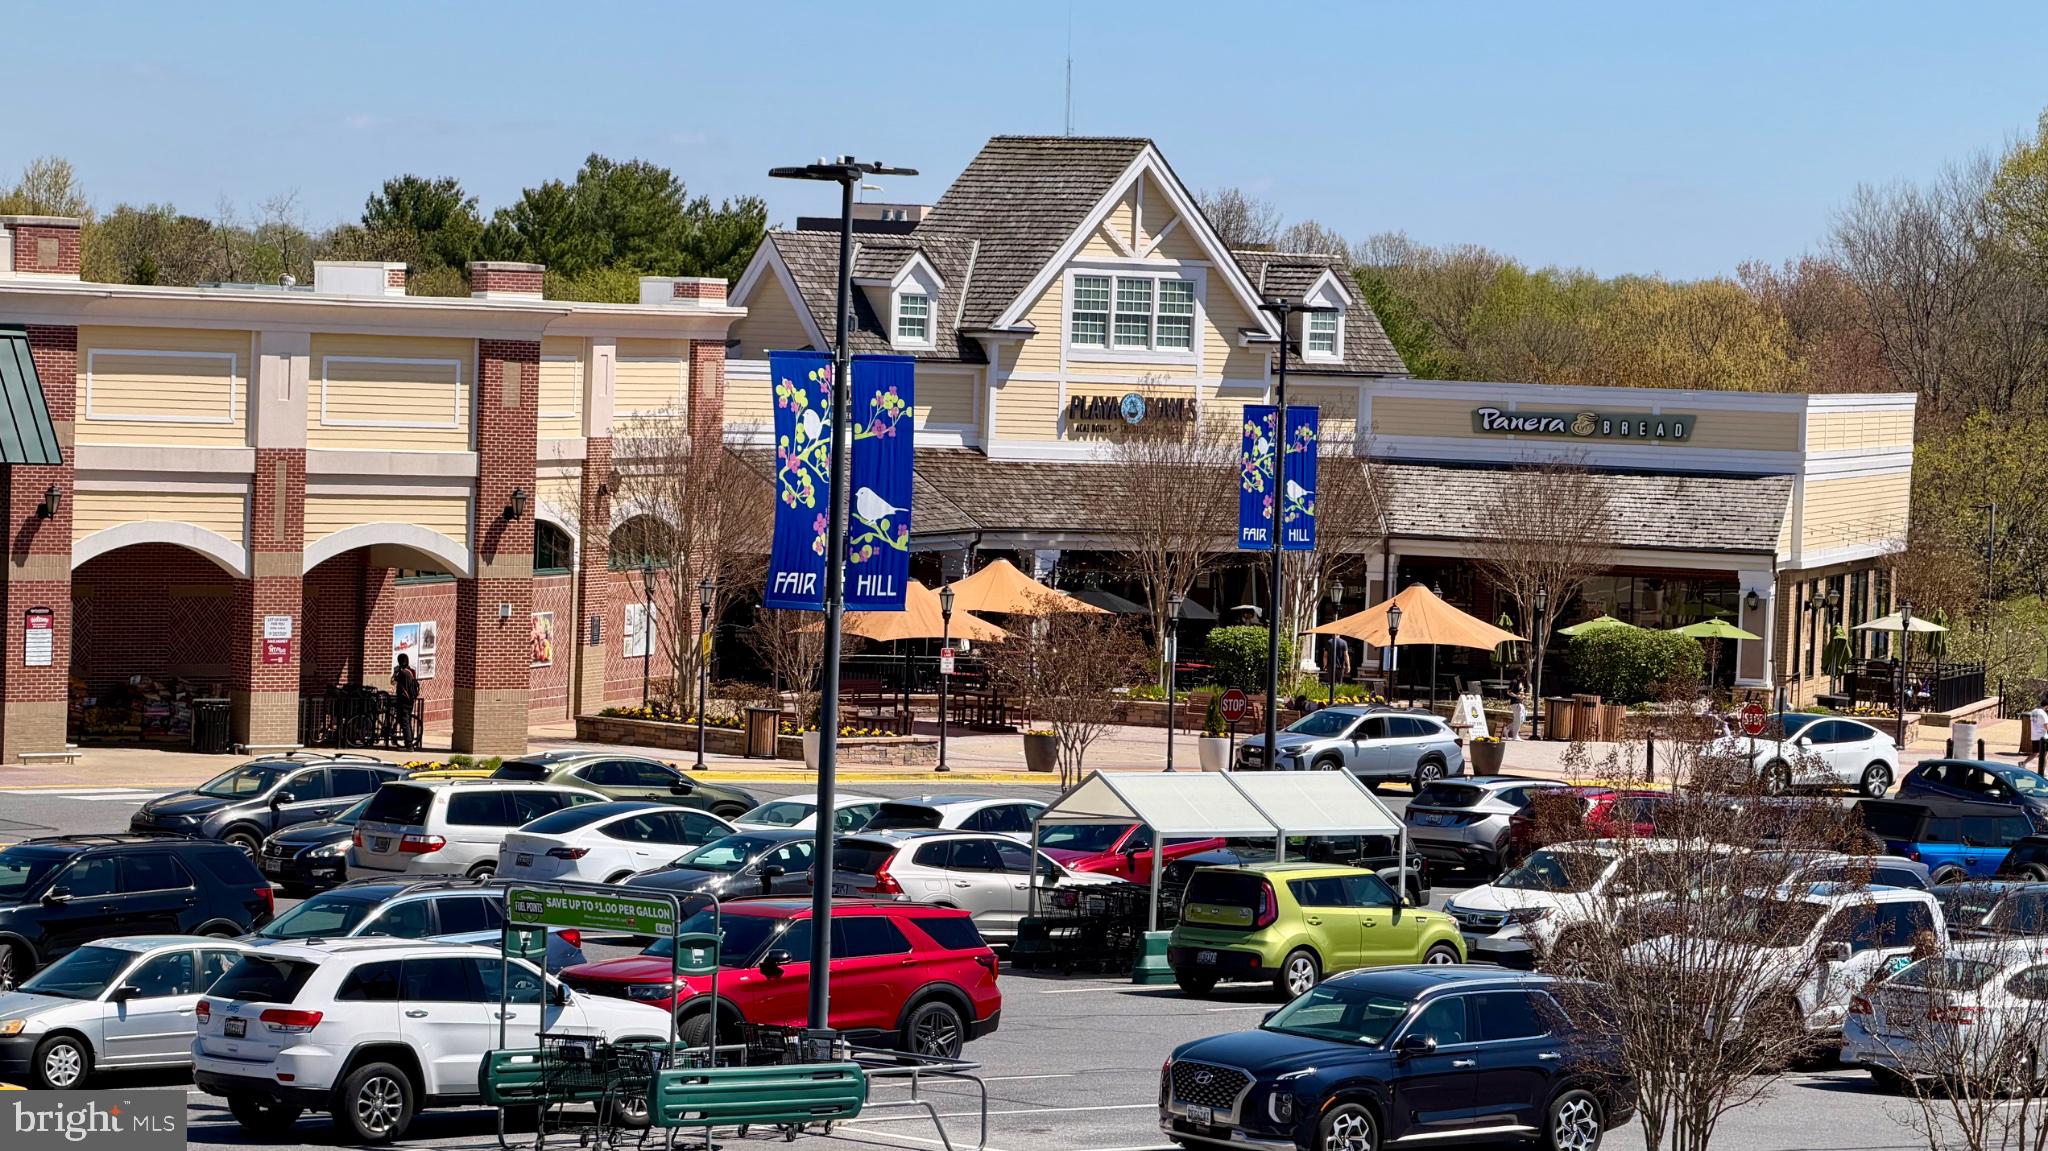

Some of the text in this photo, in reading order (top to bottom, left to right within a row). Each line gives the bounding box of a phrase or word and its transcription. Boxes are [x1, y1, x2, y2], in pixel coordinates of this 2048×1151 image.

[1070, 395, 1120, 419] PLAYA
[1478, 408, 1683, 438] Panera BREAD
[1243, 527, 1310, 542] FAIR HILL
[774, 572, 896, 596] FAIR HILL
[1222, 698, 1244, 711] STOP
[1744, 713, 1763, 726] STOP
[515, 901, 543, 913] FUEL POINTS
[546, 897, 568, 909] SAVE
[568, 899, 580, 910] UP
[582, 900, 593, 911] TO
[594, 901, 617, 914] $1.00
[619, 904, 635, 916] PER
[636, 906, 670, 919] GALLON
